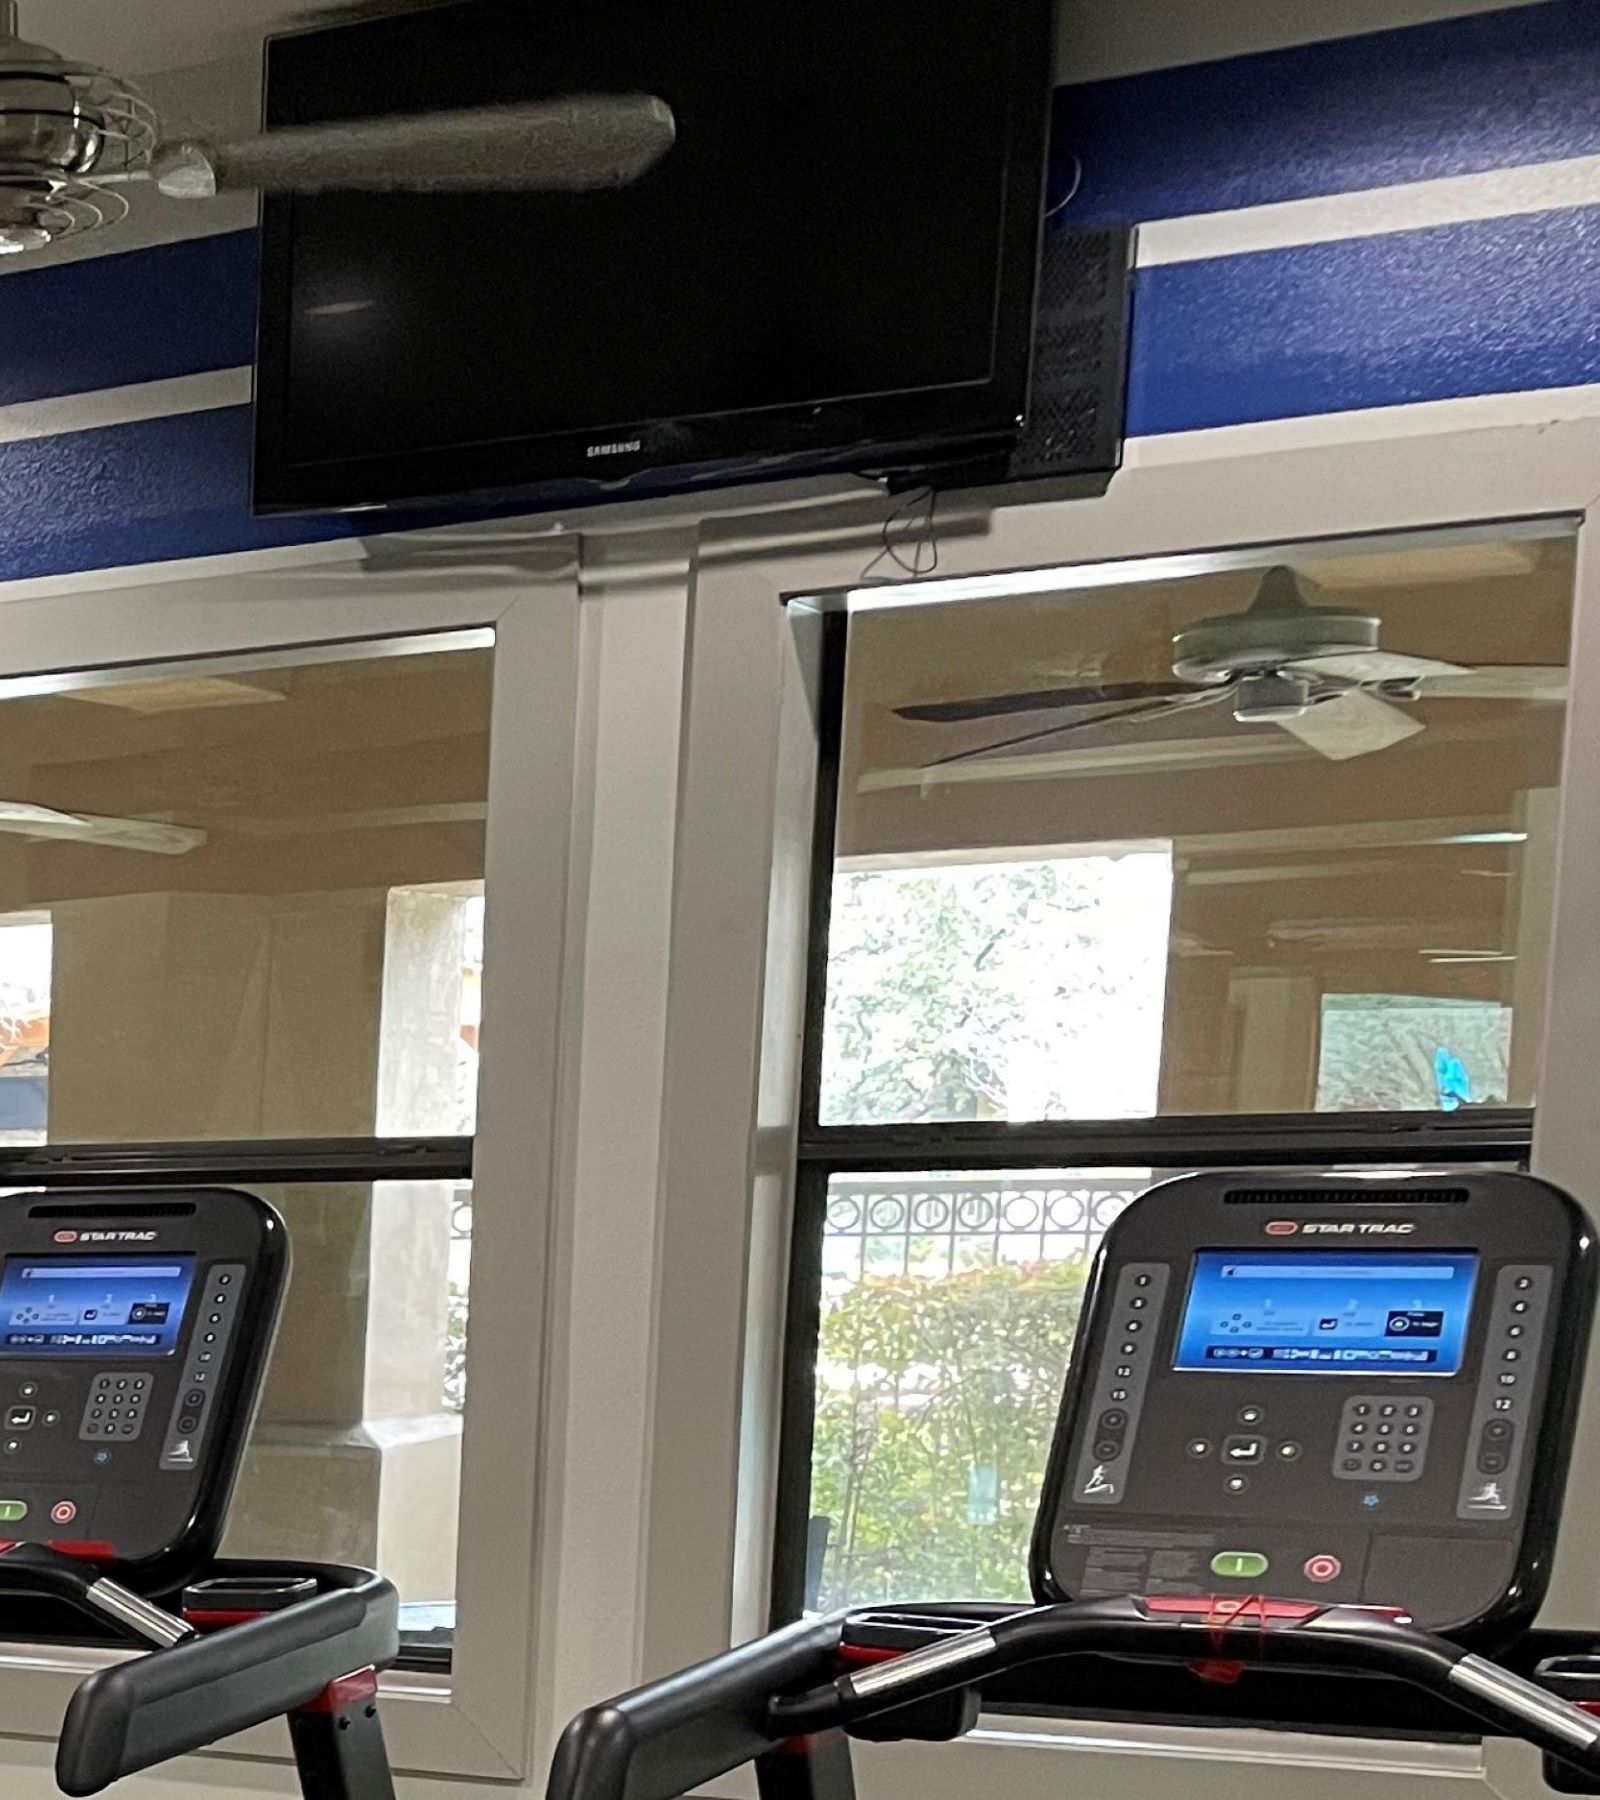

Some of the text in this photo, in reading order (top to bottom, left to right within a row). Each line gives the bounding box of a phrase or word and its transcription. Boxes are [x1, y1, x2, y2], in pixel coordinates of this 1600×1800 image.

[586, 440, 640, 457] SAMSUNG
[1302, 1223, 1415, 1234] STAR TRAC
[80, 1231, 157, 1241] STAR TRAC
